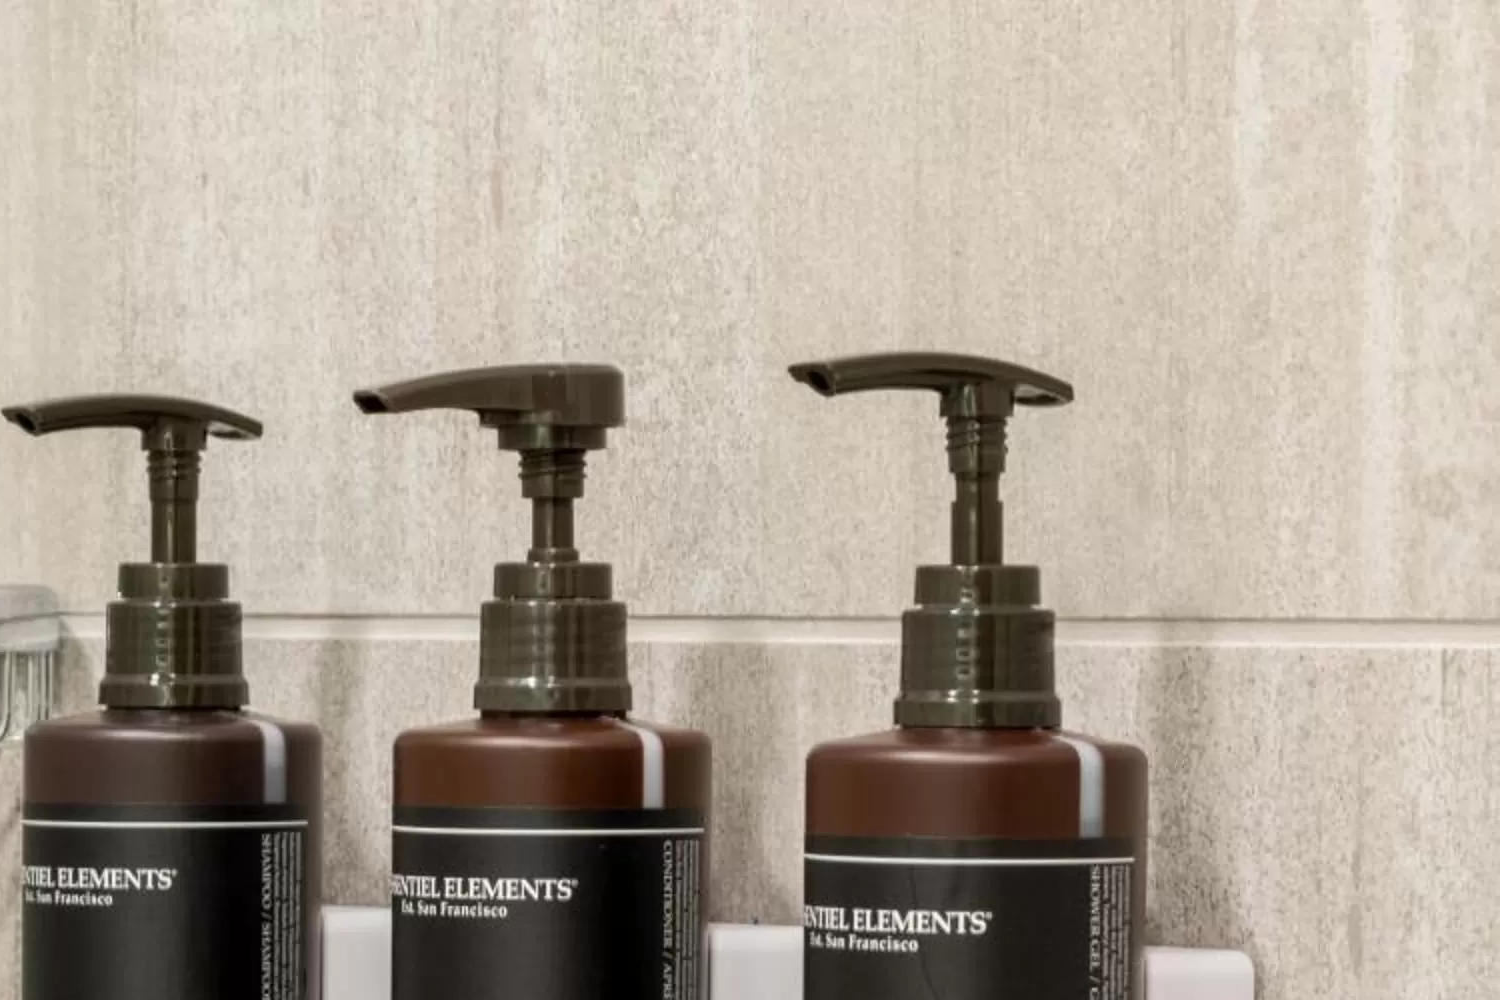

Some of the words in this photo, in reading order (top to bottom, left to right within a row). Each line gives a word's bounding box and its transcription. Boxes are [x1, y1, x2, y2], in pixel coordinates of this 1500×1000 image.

[417, 900, 437, 916] San
[440, 900, 508, 918] Francisco
[849, 933, 919, 952] Francisco
